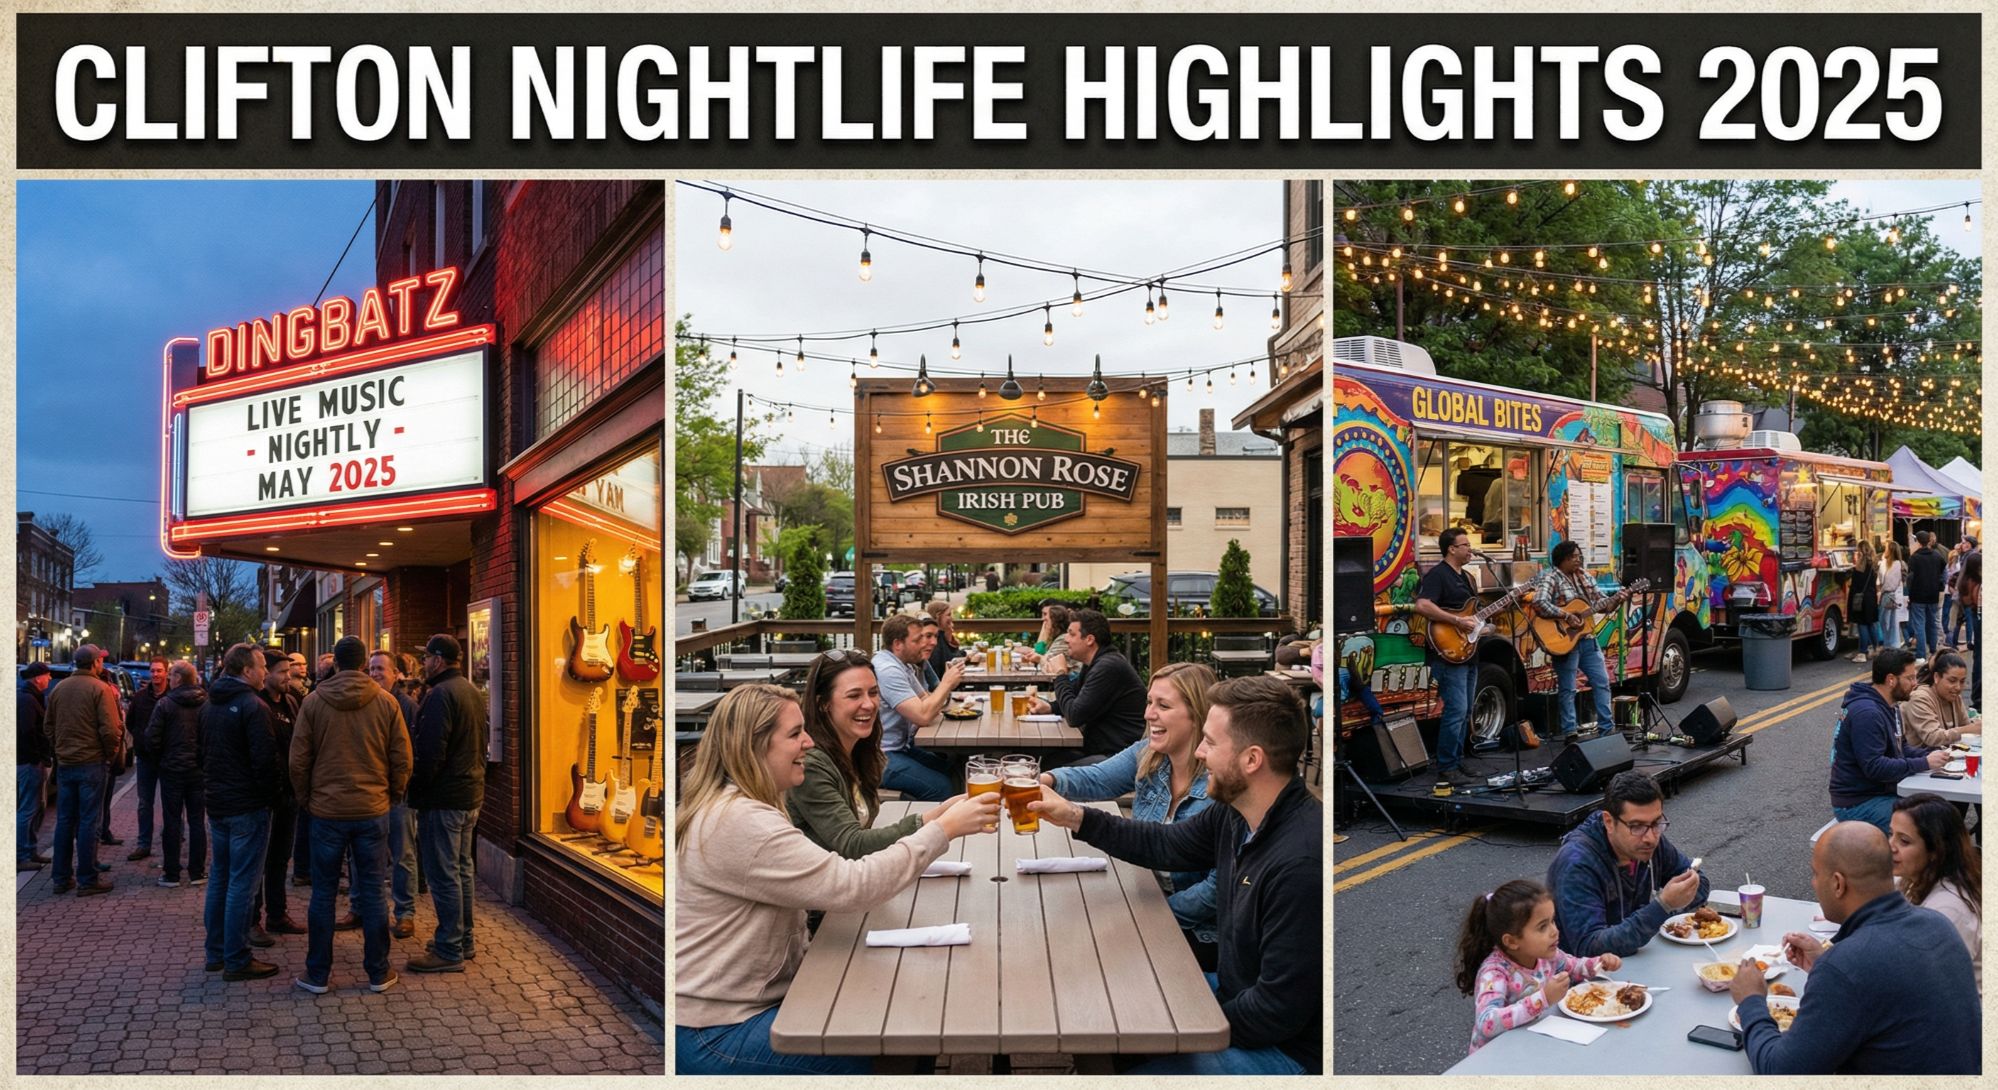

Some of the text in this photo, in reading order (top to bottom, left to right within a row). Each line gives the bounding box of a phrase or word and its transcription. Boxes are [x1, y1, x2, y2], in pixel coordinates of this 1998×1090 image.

[205, 266, 460, 379] DINGBATZ
[247, 375, 406, 432] LIVE MUSIC
[1412, 386, 1542, 433] GLOBAL BITES
[268, 418, 382, 464] NIGHTLY
[990, 428, 1032, 445] THE
[257, 454, 397, 501] MAY 2025
[893, 455, 1130, 493] SHANNON ROSE
[957, 492, 1065, 510] IRISH PUB
